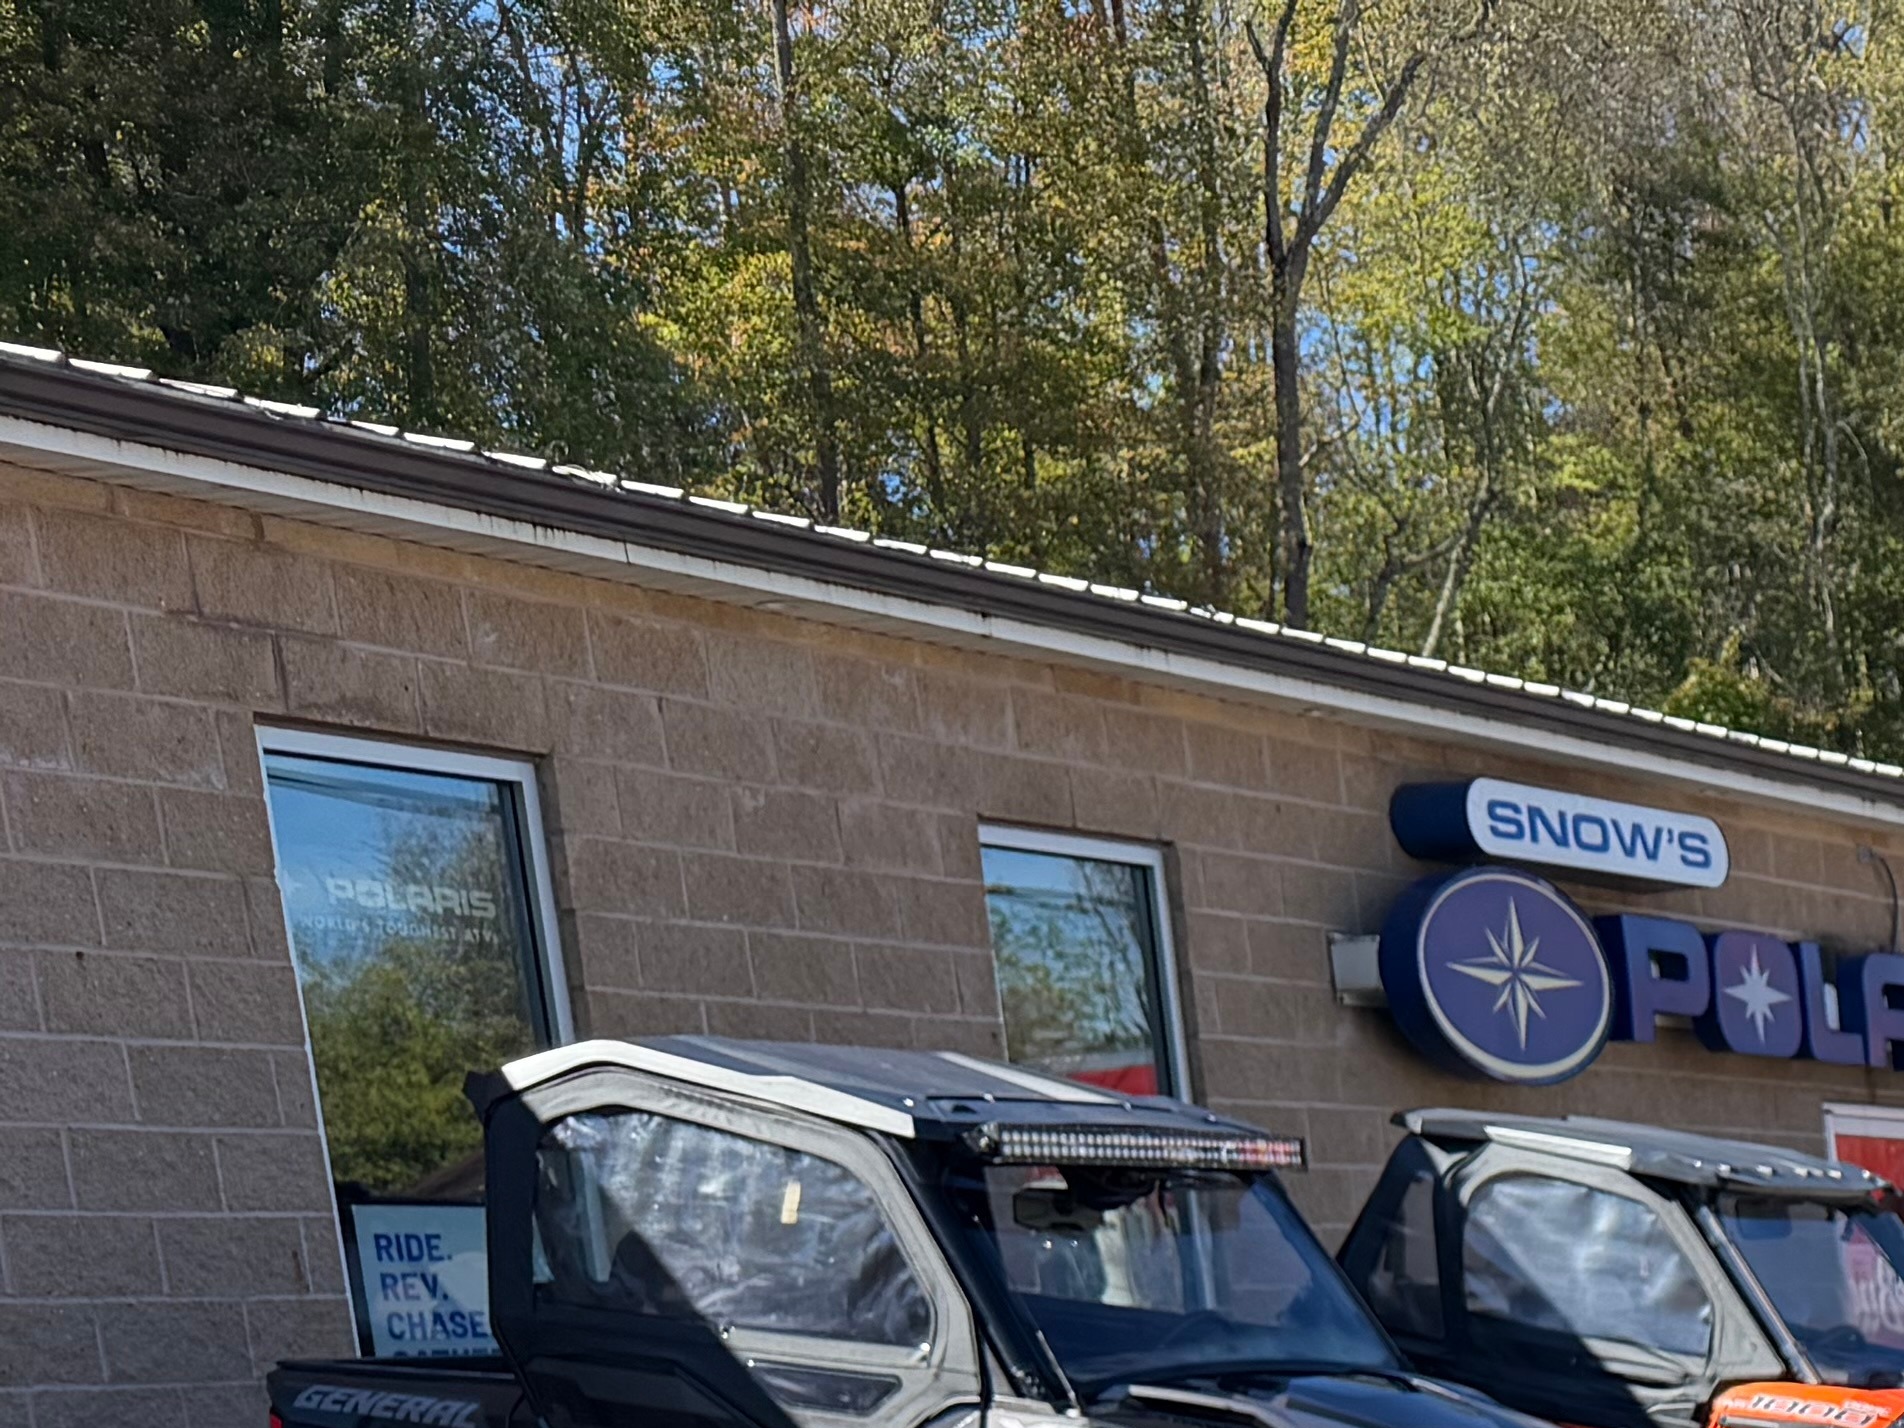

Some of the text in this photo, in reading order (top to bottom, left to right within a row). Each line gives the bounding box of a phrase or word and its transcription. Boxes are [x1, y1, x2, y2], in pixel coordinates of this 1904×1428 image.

[1486, 799, 1711, 869] SNOW'S
[325, 877, 497, 920] POLARIS
[373, 1233, 452, 1262] RIDE.
[380, 1272, 449, 1302] REV.
